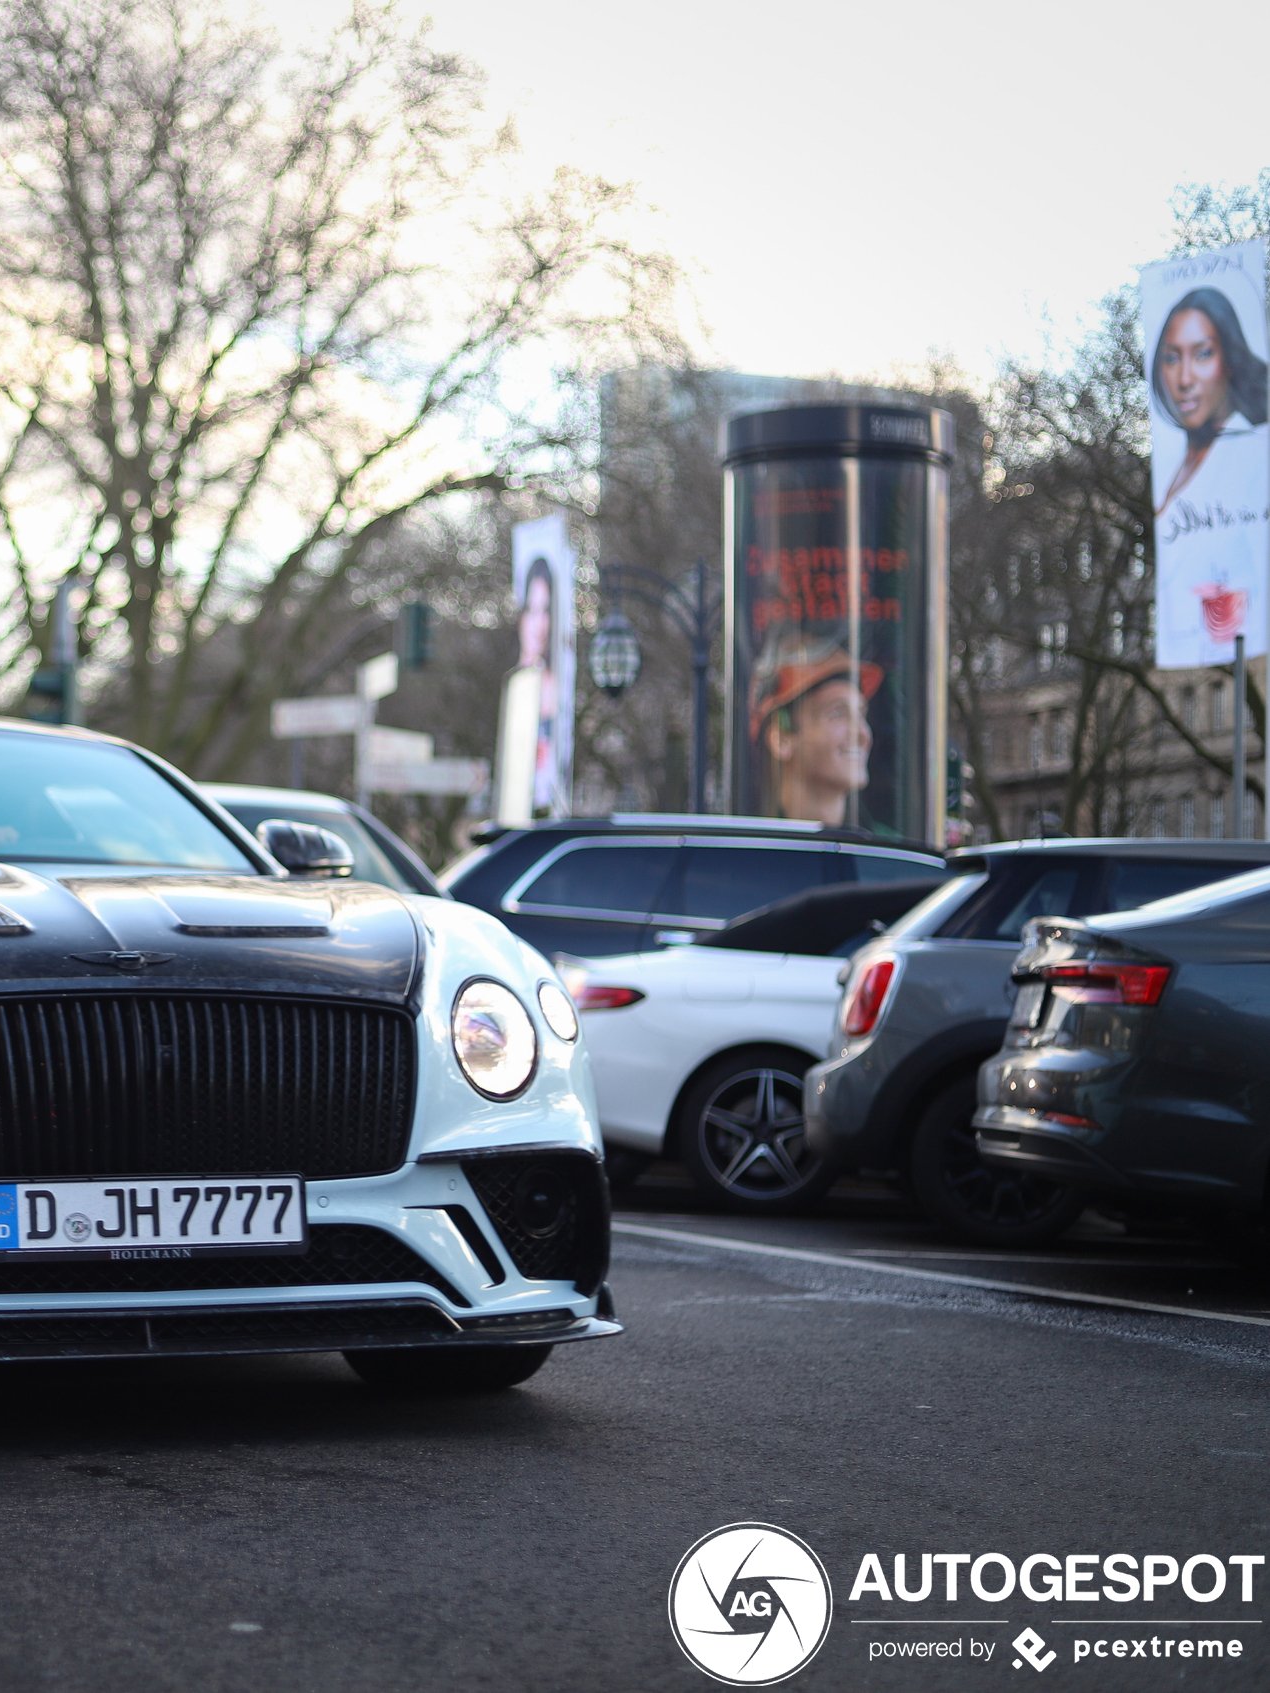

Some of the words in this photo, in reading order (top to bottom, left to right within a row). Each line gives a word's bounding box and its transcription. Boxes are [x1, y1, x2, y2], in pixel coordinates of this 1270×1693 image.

[752, 592, 902, 630] gestalen
[25, 1189, 57, 1240] D
[96, 1187, 161, 1238] JH
[173, 1185, 293, 1236] 7777
[110, 1249, 192, 1260] HOLLMANN
